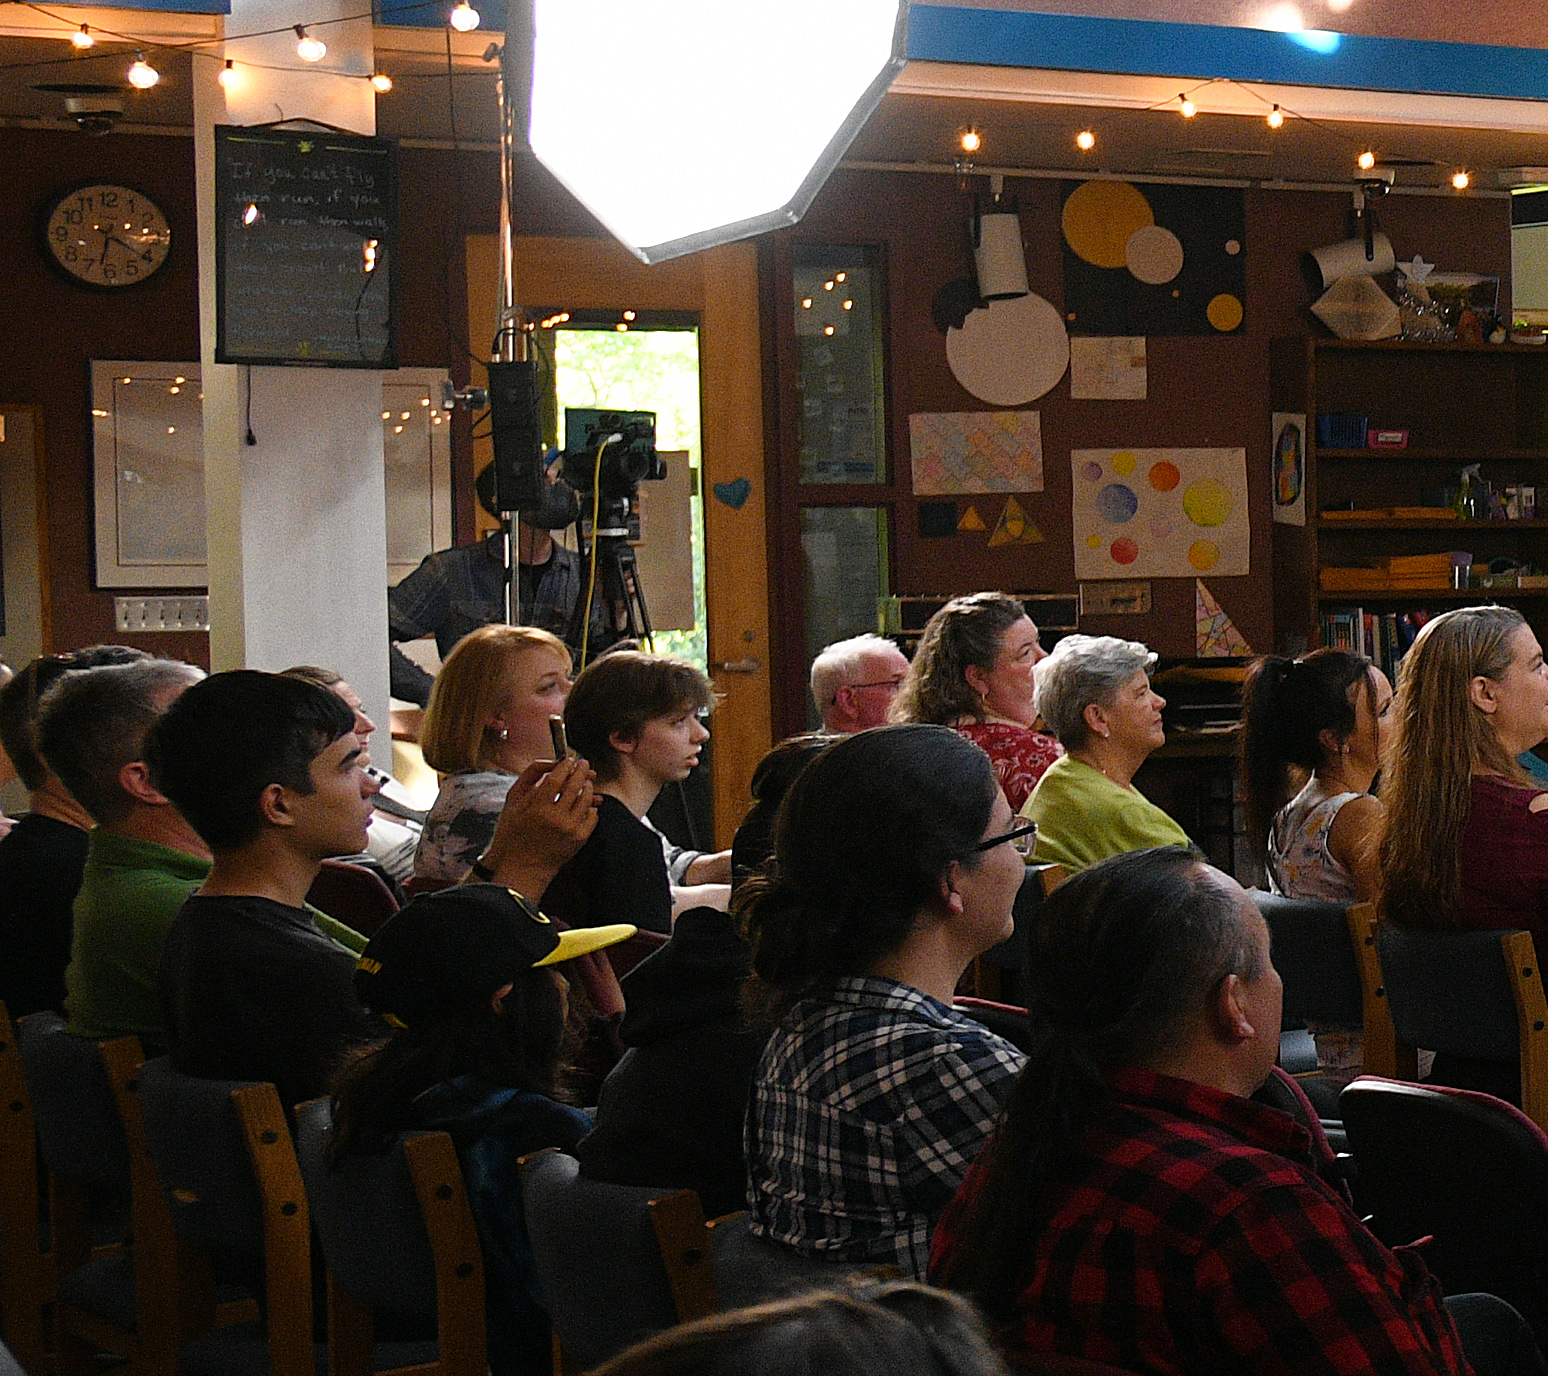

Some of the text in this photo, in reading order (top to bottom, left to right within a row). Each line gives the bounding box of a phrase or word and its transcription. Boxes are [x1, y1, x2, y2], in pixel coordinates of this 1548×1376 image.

[78, 197, 93, 212] 11
[100, 192, 119, 208] 12
[129, 199, 135, 213] 1
[63, 209, 83, 224] 10
[55, 226, 68, 241] 9
[65, 245, 78, 263] 8
[142, 248, 152, 263] 4
[82, 258, 95, 273] 7
[104, 264, 116, 279] 6
[126, 260, 138, 276] 5
